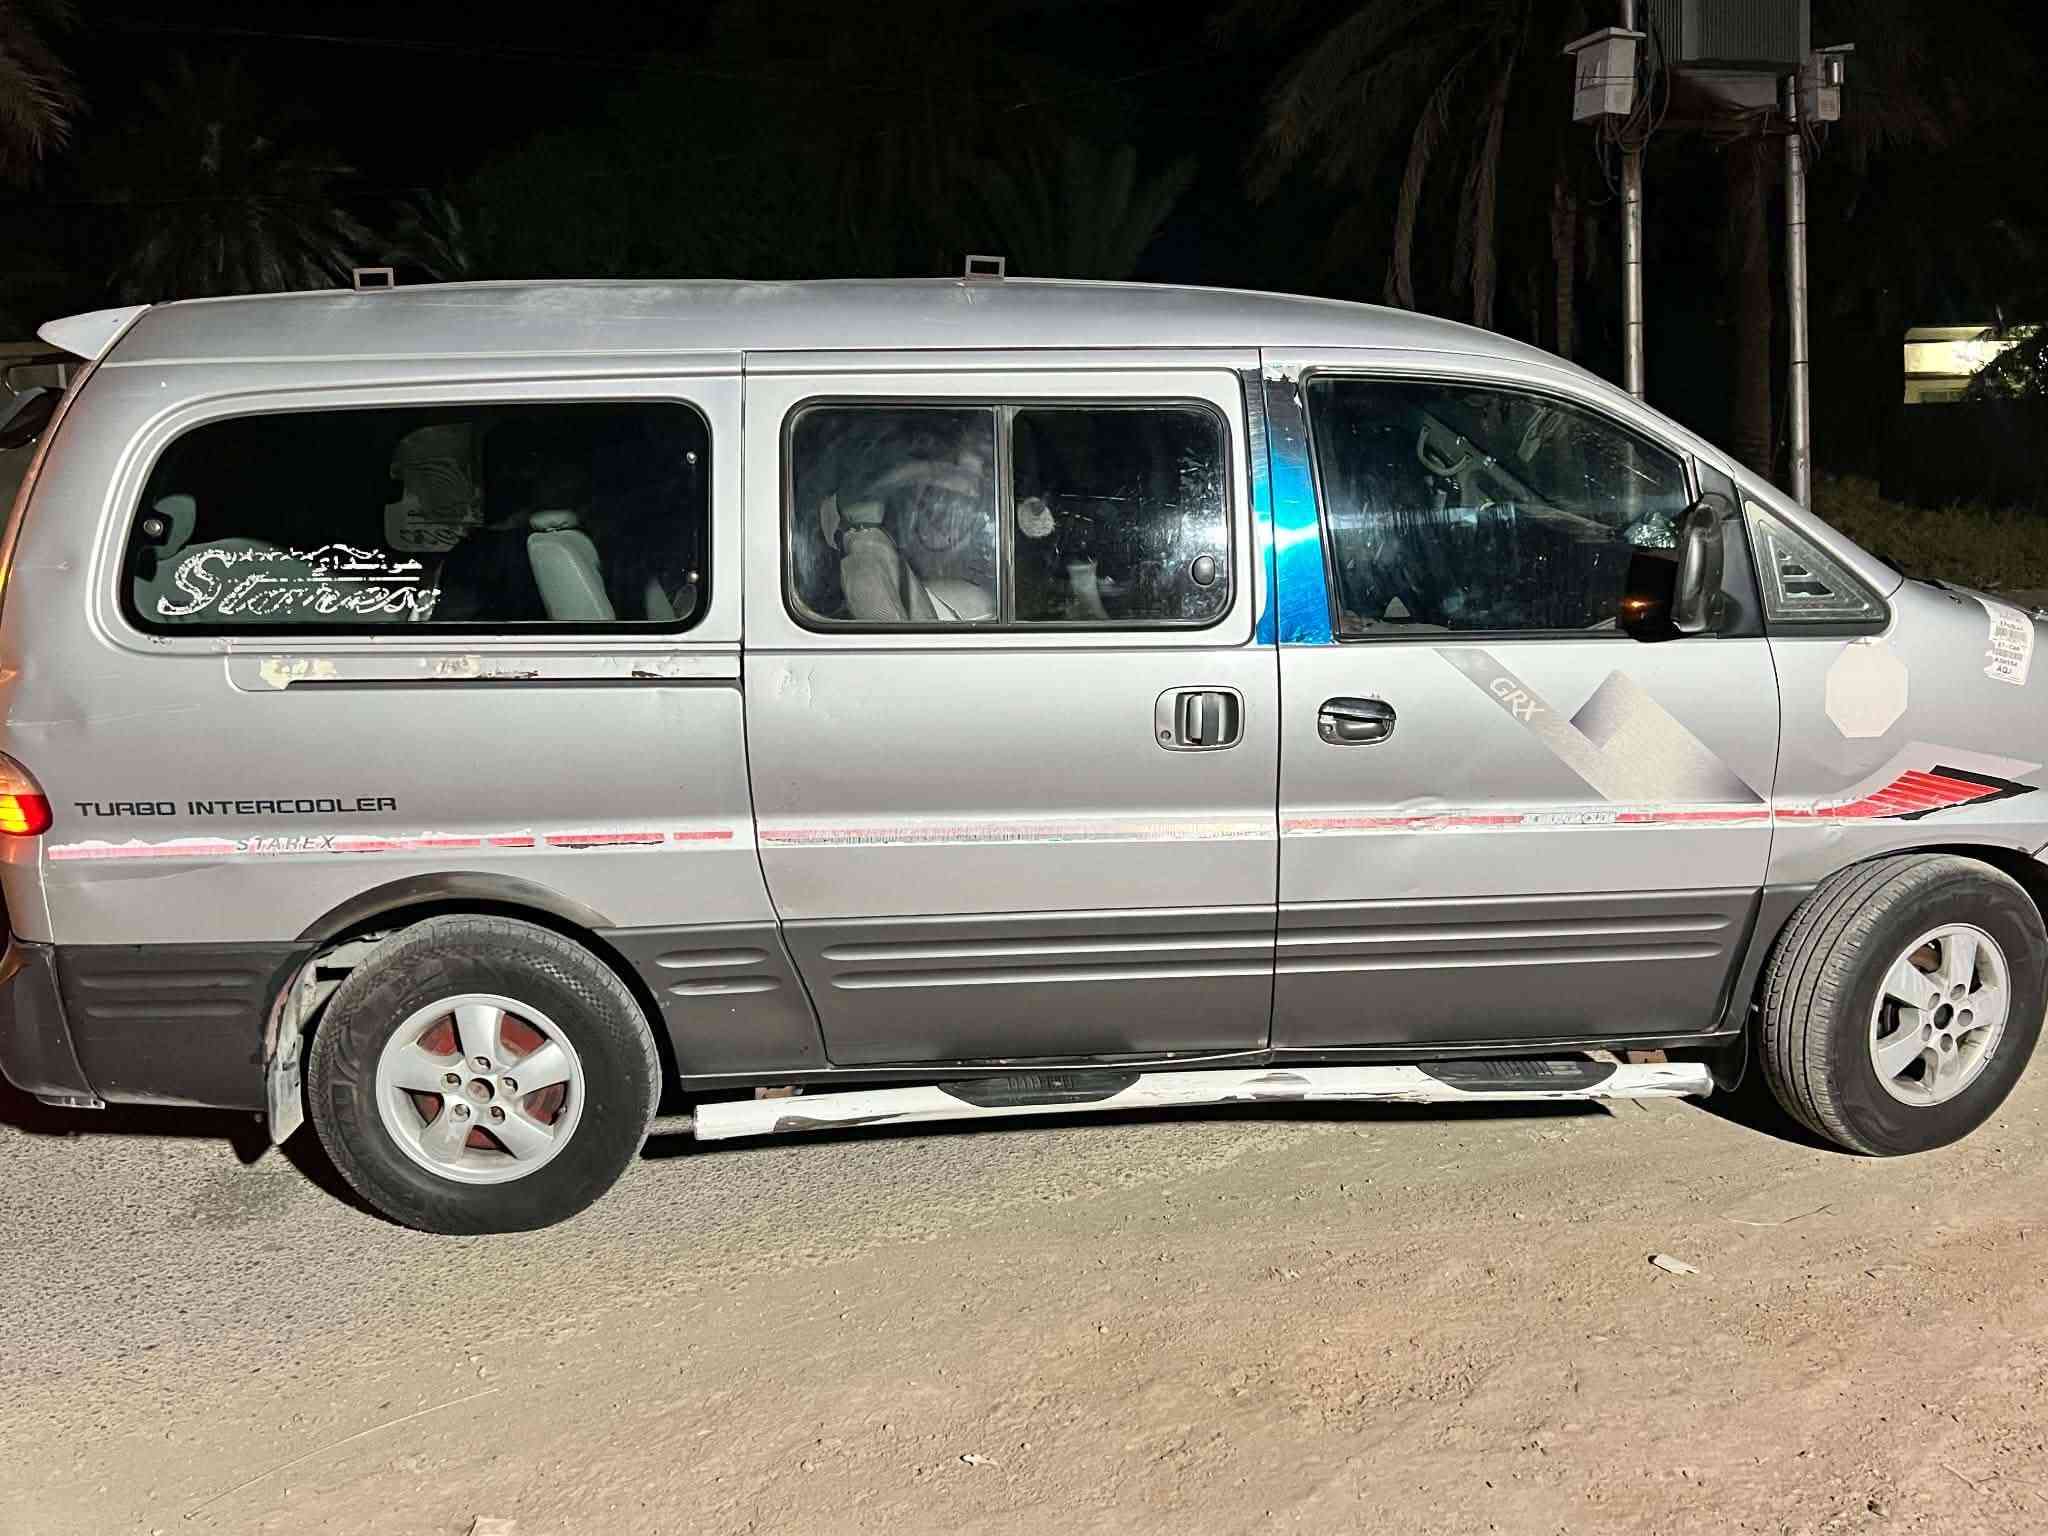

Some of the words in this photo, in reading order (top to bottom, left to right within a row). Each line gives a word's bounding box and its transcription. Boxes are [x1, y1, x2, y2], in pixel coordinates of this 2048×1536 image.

[1489, 677, 1545, 721] GRX
[74, 801, 177, 816] TURBO
[188, 797, 398, 816] INTERCOOLER
[237, 834, 336, 850] STAREX
